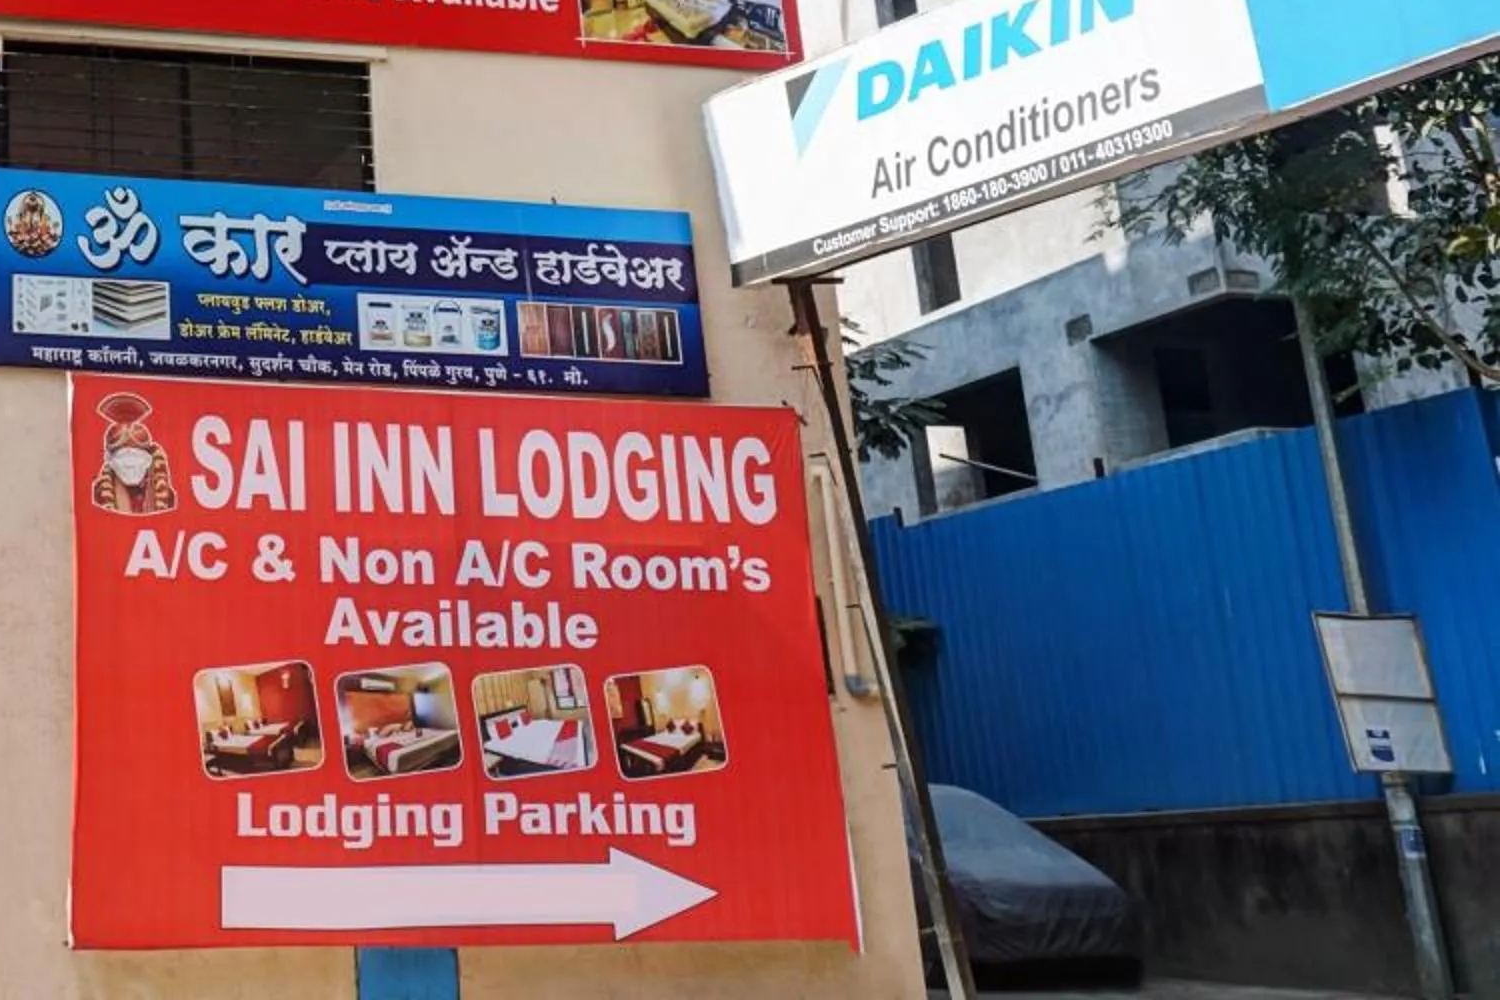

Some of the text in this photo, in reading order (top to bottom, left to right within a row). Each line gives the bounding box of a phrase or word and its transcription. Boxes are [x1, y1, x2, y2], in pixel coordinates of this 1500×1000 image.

[871, 66, 1162, 200] Air Conditioners
[813, 222, 877, 257] Customer
[880, 202, 940, 237] Support:
[943, 163, 1048, 213] 1860-180-3900
[1060, 119, 1173, 175] 011-40319300
[179, 211, 308, 285] कार
[324, 239, 418, 277] प्लाय
[533, 243, 686, 291] हार्डवेअर
[192, 416, 779, 525] SAI INN LODGING
[125, 530, 771, 593] A/C & Non A/C Room's
[325, 596, 599, 650] Available
[237, 792, 696, 848] Lodging Parking
